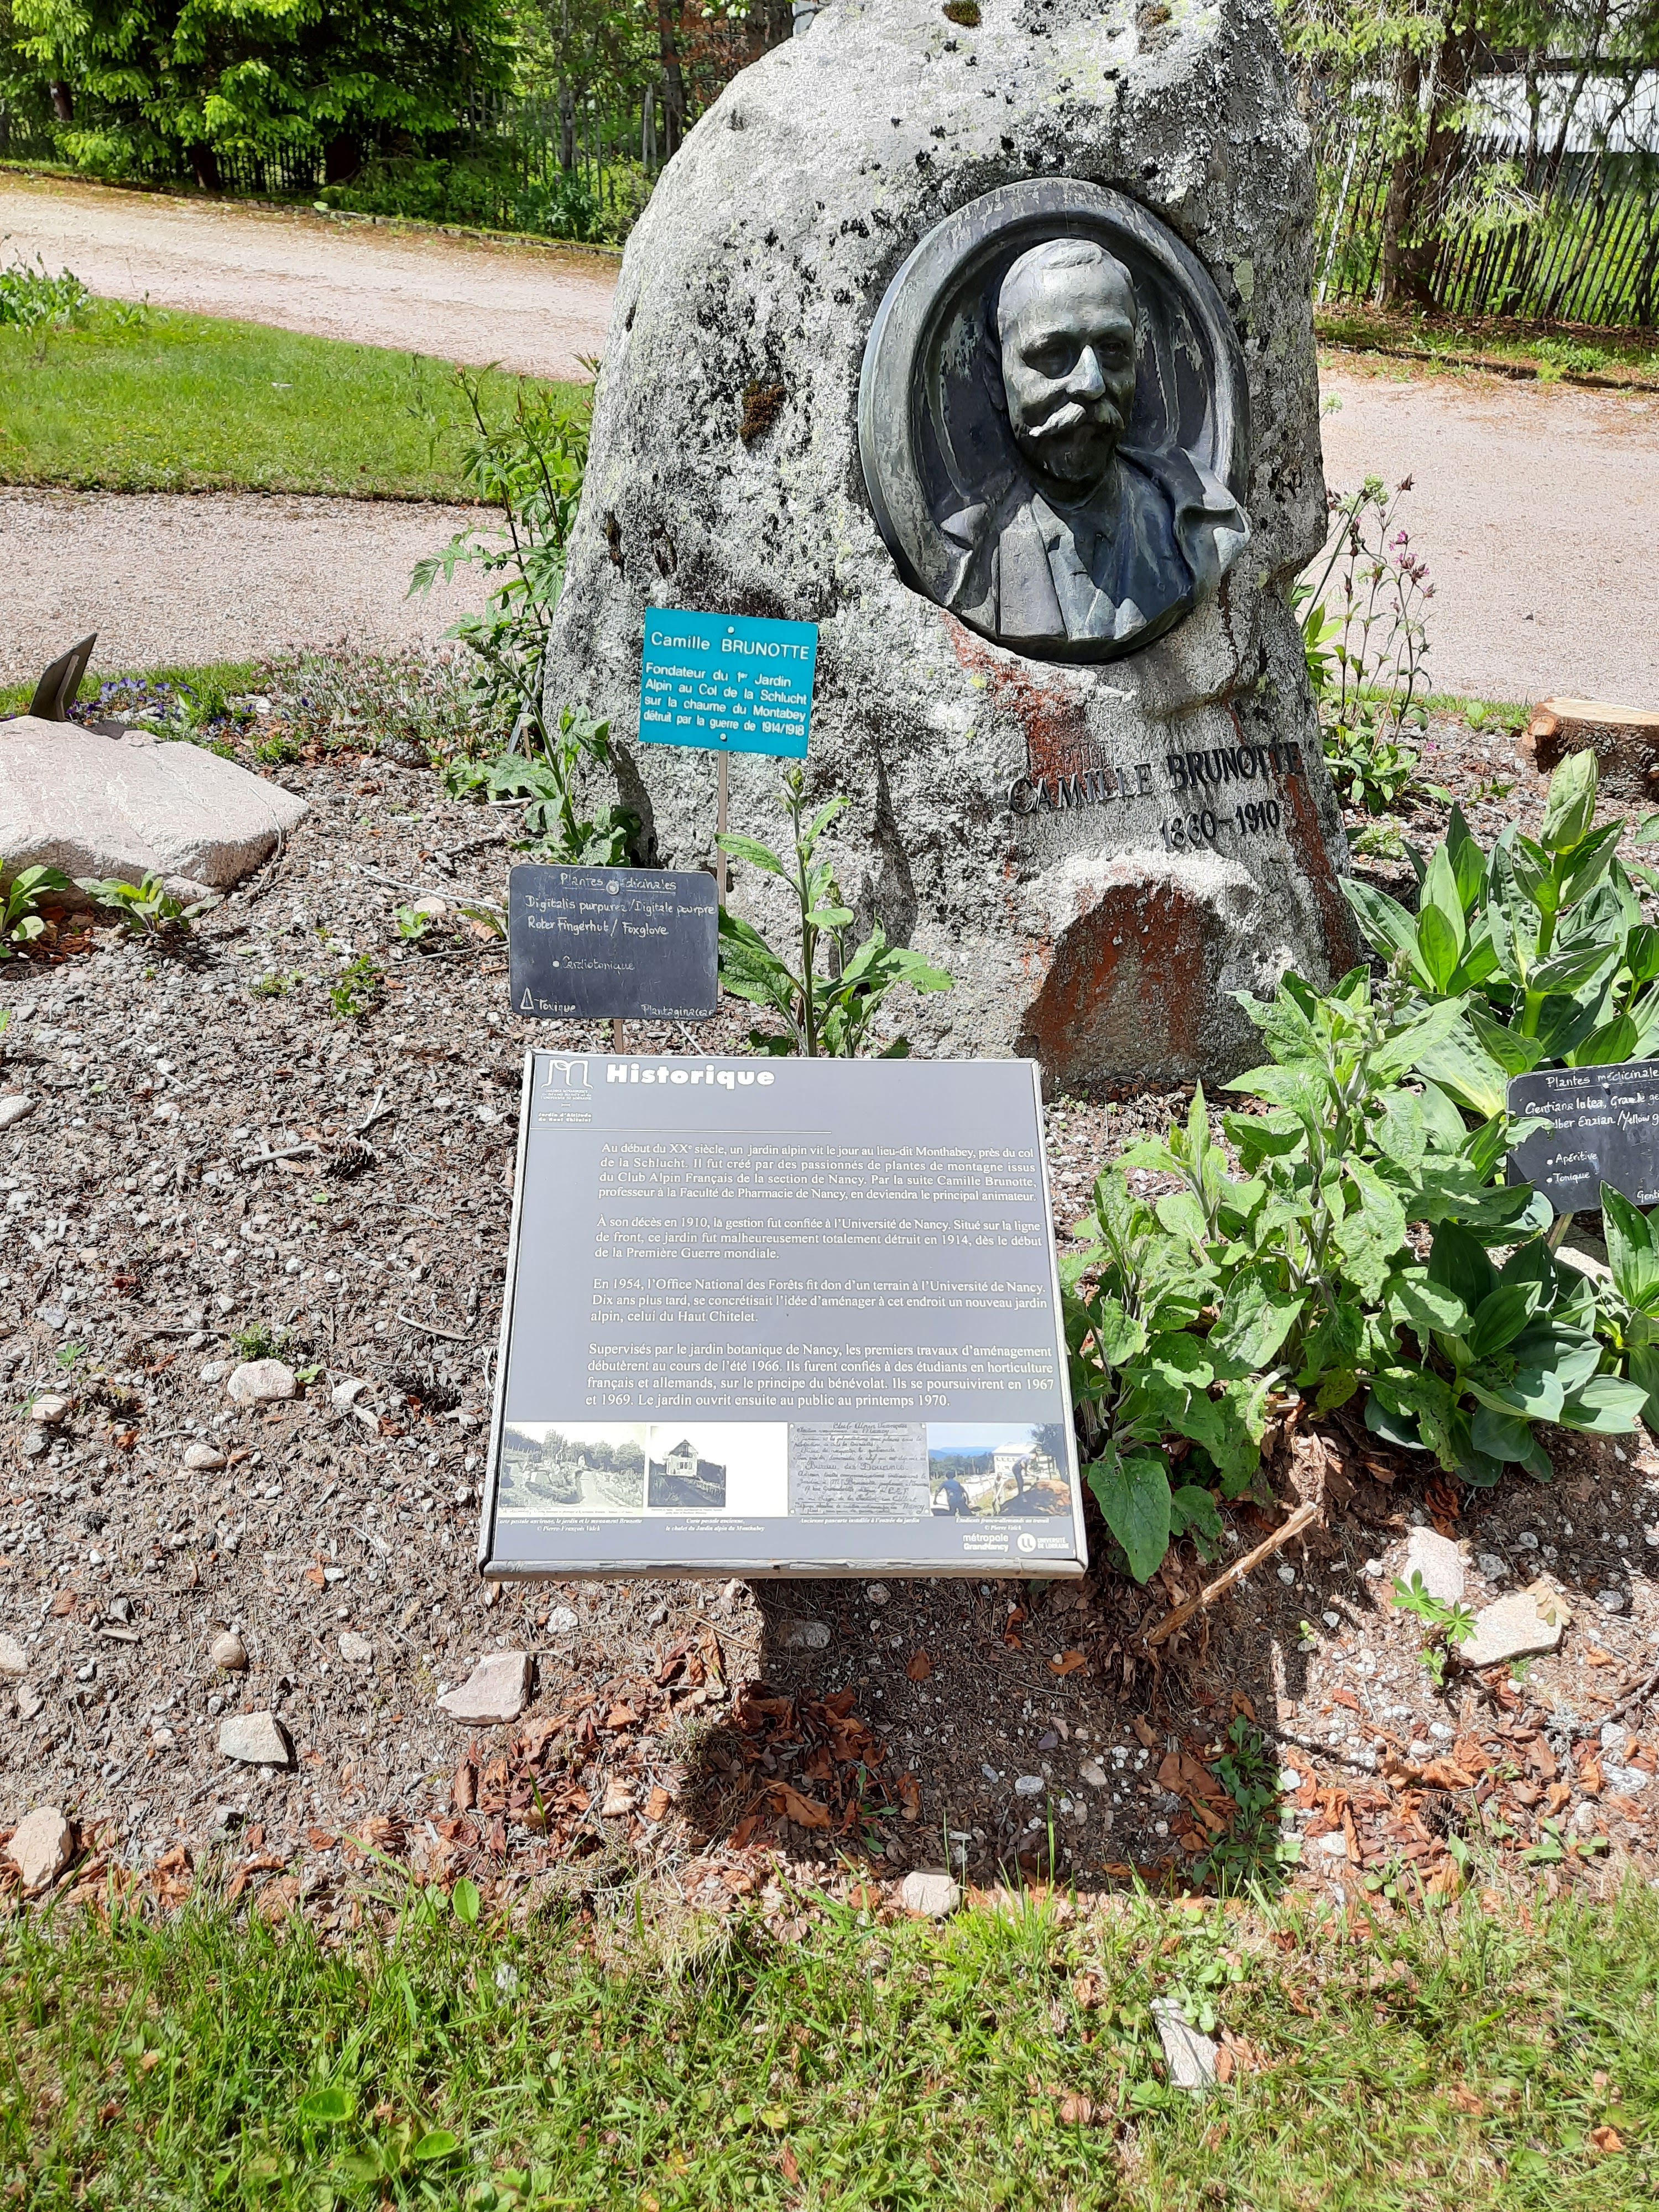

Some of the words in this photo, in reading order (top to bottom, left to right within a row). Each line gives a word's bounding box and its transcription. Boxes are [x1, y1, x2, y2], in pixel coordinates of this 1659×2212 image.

[651, 632, 710, 650] Camille
[722, 639, 810, 660] BRUNOTTE
[645, 662, 706, 679] Fondateur
[713, 669, 728, 681] du
[737, 672, 748, 682] 1er
[754, 674, 791, 687] Jardin
[645, 678, 672, 692] Alpin
[678, 684, 692, 693] au
[698, 683, 717, 696] Col
[723, 686, 738, 698] de
[744, 688, 754, 700] la
[760, 689, 807, 705] Schlucht
[644, 696, 661, 706] sur
[667, 696, 677, 707] la
[684, 698, 727, 712] chaume
[732, 703, 747, 714] du
[753, 705, 806, 723] Montabey
[643, 709, 672, 723] détruit
[676, 715, 692, 726] par
[696, 715, 705, 726] la
[709, 718, 739, 729] guerre
[743, 720, 756, 732] de
[761, 721, 805, 736] 1914/1918
[1008, 761, 1155, 814] CAMILLE
[1166, 741, 1305, 791] BRUNOTTE
[560, 872, 603, 886] Plantes
[525, 895, 576, 912] Digitalis
[676, 905, 716, 916] pourpre
[528, 917, 555, 930] Roter
[557, 917, 609, 936] Fingerhut
[622, 922, 669, 938] Foxglove
[562, 956, 635, 974] Cardiotonique
[606, 1063, 775, 1090] Historique
[1546, 1076, 1590, 1088] Plantes
[1525, 1102, 1574, 1114] Gentiana
[1552, 1118, 1575, 1129] lber
[1578, 1115, 1616, 1128] Enzian
[602, 1143, 618, 1152] Au
[620, 1143, 650, 1153] début
[653, 1143, 666, 1153] du
[669, 1144, 692, 1154] XXe
[694, 1144, 727, 1156] siècle,
[747, 1144, 779, 1157] jardin
[781, 1145, 807, 1157] alpin
[827, 1145, 836, 1155] le
[836, 1145, 859, 1157] jour
[877, 1146, 913, 1156] lieu-dit
[915, 1146, 976, 1159] Monthabey,
[978, 1147, 1000, 1159] près
[1002, 1147, 1016, 1157] du
[1018, 1148, 1034, 1157] col
[600, 1157, 614, 1167] de
[619, 1157, 629, 1167] la
[634, 1157, 688, 1168] Schlucht.
[693, 1158, 701, 1168] Il
[707, 1158, 723, 1168] fut
[727, 1159, 751, 1168] créé
[755, 1161, 774, 1171] par
[778, 1159, 797, 1169] des
[801, 1159, 863, 1171] passionnés
[867, 1160, 881, 1170] de
[884, 1160, 926, 1172] plantes
[930, 1161, 943, 1171] de
[947, 1163, 1004, 1173] montagne
[1008, 1162, 1036, 1172] issus
[599, 1172, 614, 1182] du
[618, 1172, 645, 1182] Club
[649, 1172, 681, 1185] Alpin
[685, 1172, 733, 1185] Français
[737, 1173, 750, 1183] de
[754, 1173, 764, 1183] la
[768, 1173, 807, 1183] section
[811, 1173, 825, 1184] de
[828, 1174, 867, 1187] Nancy.
[872, 1175, 890, 1185] Par
[894, 1175, 903, 1185] la
[907, 1175, 933, 1185] suite
[937, 1175, 981, 1186] Camille
[985, 1176, 1037, 1188] Brunotte,
[598, 1186, 655, 1199] professeur
[658, 1187, 664, 1197] à
[667, 1187, 677, 1197] la
[680, 1187, 719, 1197] Faculté
[721, 1187, 734, 1197] de
[738, 1187, 794, 1198] Pharmacie
[796, 1188, 809, 1198] de
[810, 1188, 848, 1201] Nancy,
[866, 1189, 918, 1199] deviendra
[921, 1190, 930, 1199] le
[932, 1190, 979, 1203] principal
[982, 1190, 1036, 1202] animateur.
[589, 1343, 651, 1357] Supervisés
[655, 1346, 674, 1358] par
[677, 1343, 687, 1354] le
[688, 1343, 723, 1357] jardin
[727, 1343, 783, 1358] botanique
[786, 1343, 800, 1355] de
[802, 1344, 842, 1358] Nancy,
[846, 1344, 861, 1355] les
[864, 1343, 914, 1358] premiers
[917, 1345, 958, 1356] travaux
[962, 1344, 1052, 1359] d'aménagement
[586, 1395, 597, 1405] et
[602, 1394, 633, 1405] 1969.
[638, 1394, 654, 1405] Le
[656, 1394, 692, 1408] jardin
[695, 1394, 731, 1406] ouvrit
[734, 1394, 777, 1406] ensuite
[780, 1397, 794, 1406] au
[798, 1394, 834, 1408] public
[838, 1397, 852, 1406] au
[855, 1394, 914, 1409] printemps
[919, 1394, 950, 1406] 1970.
[963, 1533, 1009, 1544] métropole
